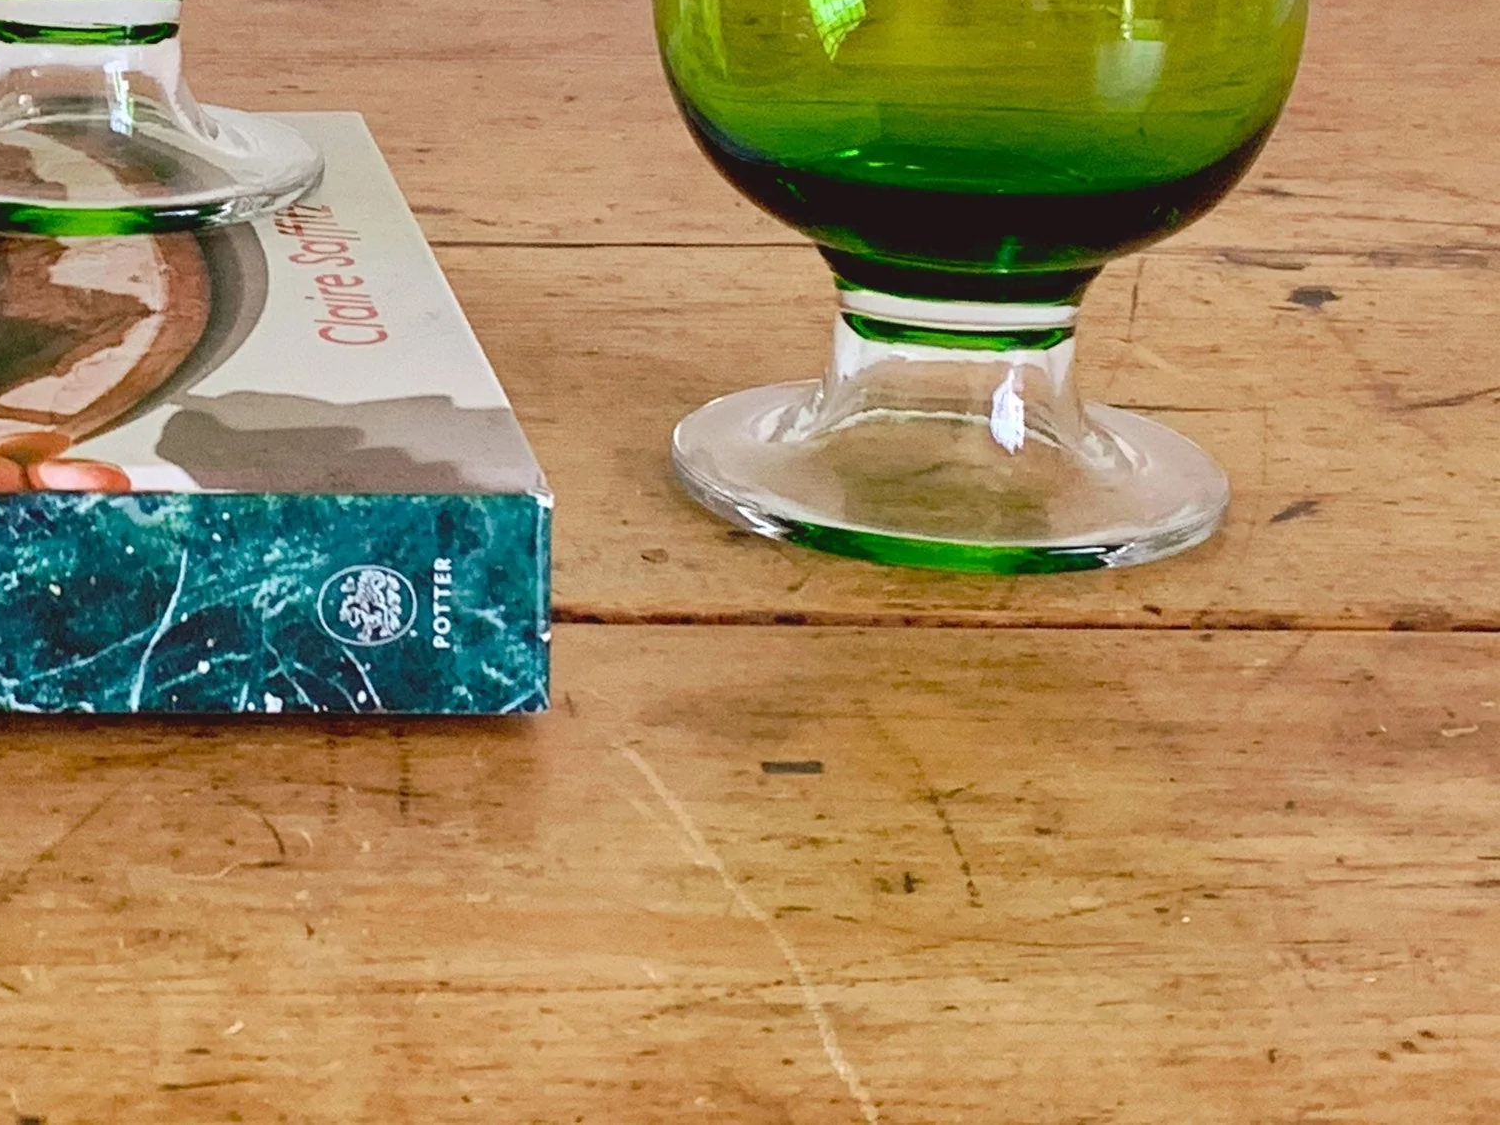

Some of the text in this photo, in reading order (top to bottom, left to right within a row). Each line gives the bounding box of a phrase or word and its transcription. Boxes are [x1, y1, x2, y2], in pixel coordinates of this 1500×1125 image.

[273, 202, 388, 345] Claire Saffitz
[432, 557, 453, 649] POTTER
